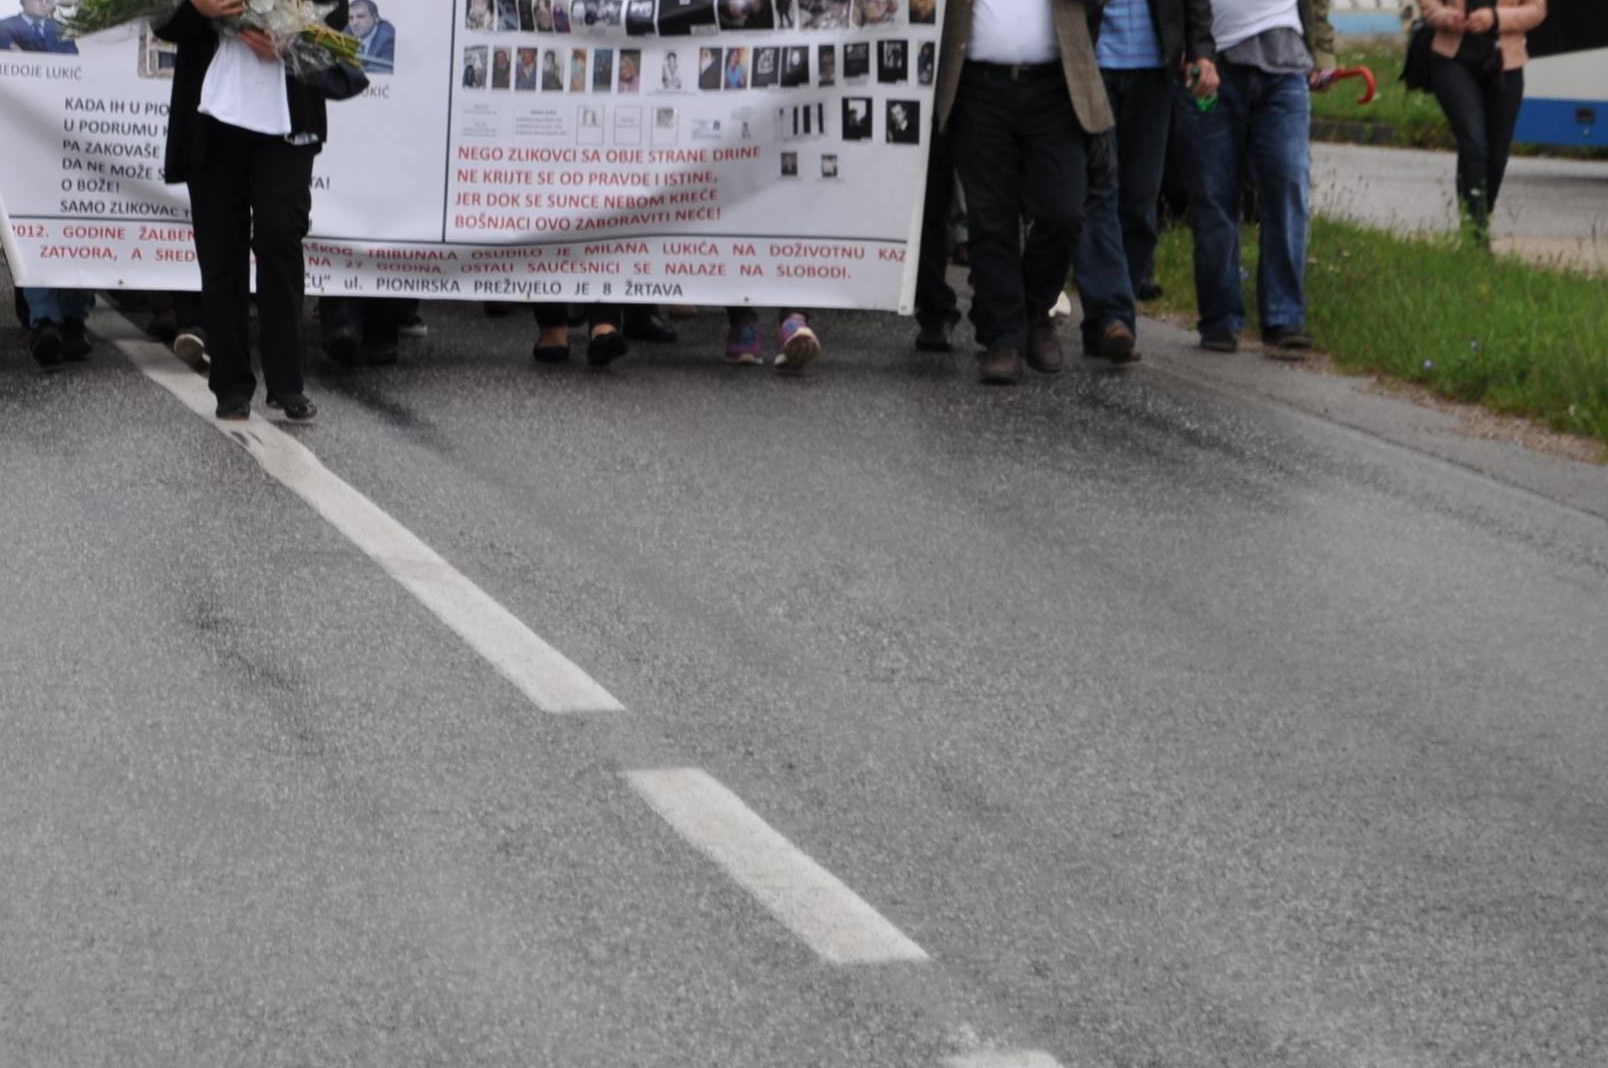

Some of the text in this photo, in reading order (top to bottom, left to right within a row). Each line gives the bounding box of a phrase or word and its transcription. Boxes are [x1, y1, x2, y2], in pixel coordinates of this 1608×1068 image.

[45, 64, 83, 81] LUKIĆ
[64, 97, 170, 117] KADA IH U PIO
[63, 119, 75, 133] U
[78, 119, 159, 138] PODRUMU
[63, 139, 161, 160] PA ZAKOVAŠE
[457, 145, 761, 164] NEGO ZLIKOVCI SA OBJE STRANE DRINE
[62, 158, 83, 171] DA
[86, 160, 107, 174] NE
[110, 163, 154, 181] MOŽE
[456, 169, 478, 184] NE
[483, 170, 532, 185] KRIJTE
[537, 172, 555, 186] SE
[560, 172, 584, 186] OD
[588, 172, 650, 187] PRAVDE
[654, 173, 660, 186] I
[61, 177, 121, 194] O BOŽE!
[60, 199, 106, 214] SAMO
[109, 200, 179, 218] ZLIKOVAC
[455, 188, 718, 210] JER DOK SE SUNCE NEBOM KREĆE
[455, 206, 722, 232] BOŠNJACI OVO ZABORAVITI NEĆE!
[62, 224, 127, 241] GODINE
[138, 224, 196, 243] ŽALBEN
[40, 245, 196, 264] ZATVORA, A SRED
[301, 238, 907, 263] AŠKOG TRIBUNALA OSUDILO JE MILANA LUKIĆA NA DOŽIVOTNU KAZ
[309, 255, 852, 280] NA 27 GODINA. OSTALI SAUČESNICI SE NALAZE NA SLOBODI.
[344, 275, 363, 291] ul.
[376, 276, 462, 294] PIONIRSKA
[473, 277, 563, 296] PREŽIVJELO
[574, 281, 590, 296] JE
[602, 282, 613, 296] 8
[624, 278, 684, 298] ŽRTAVA
